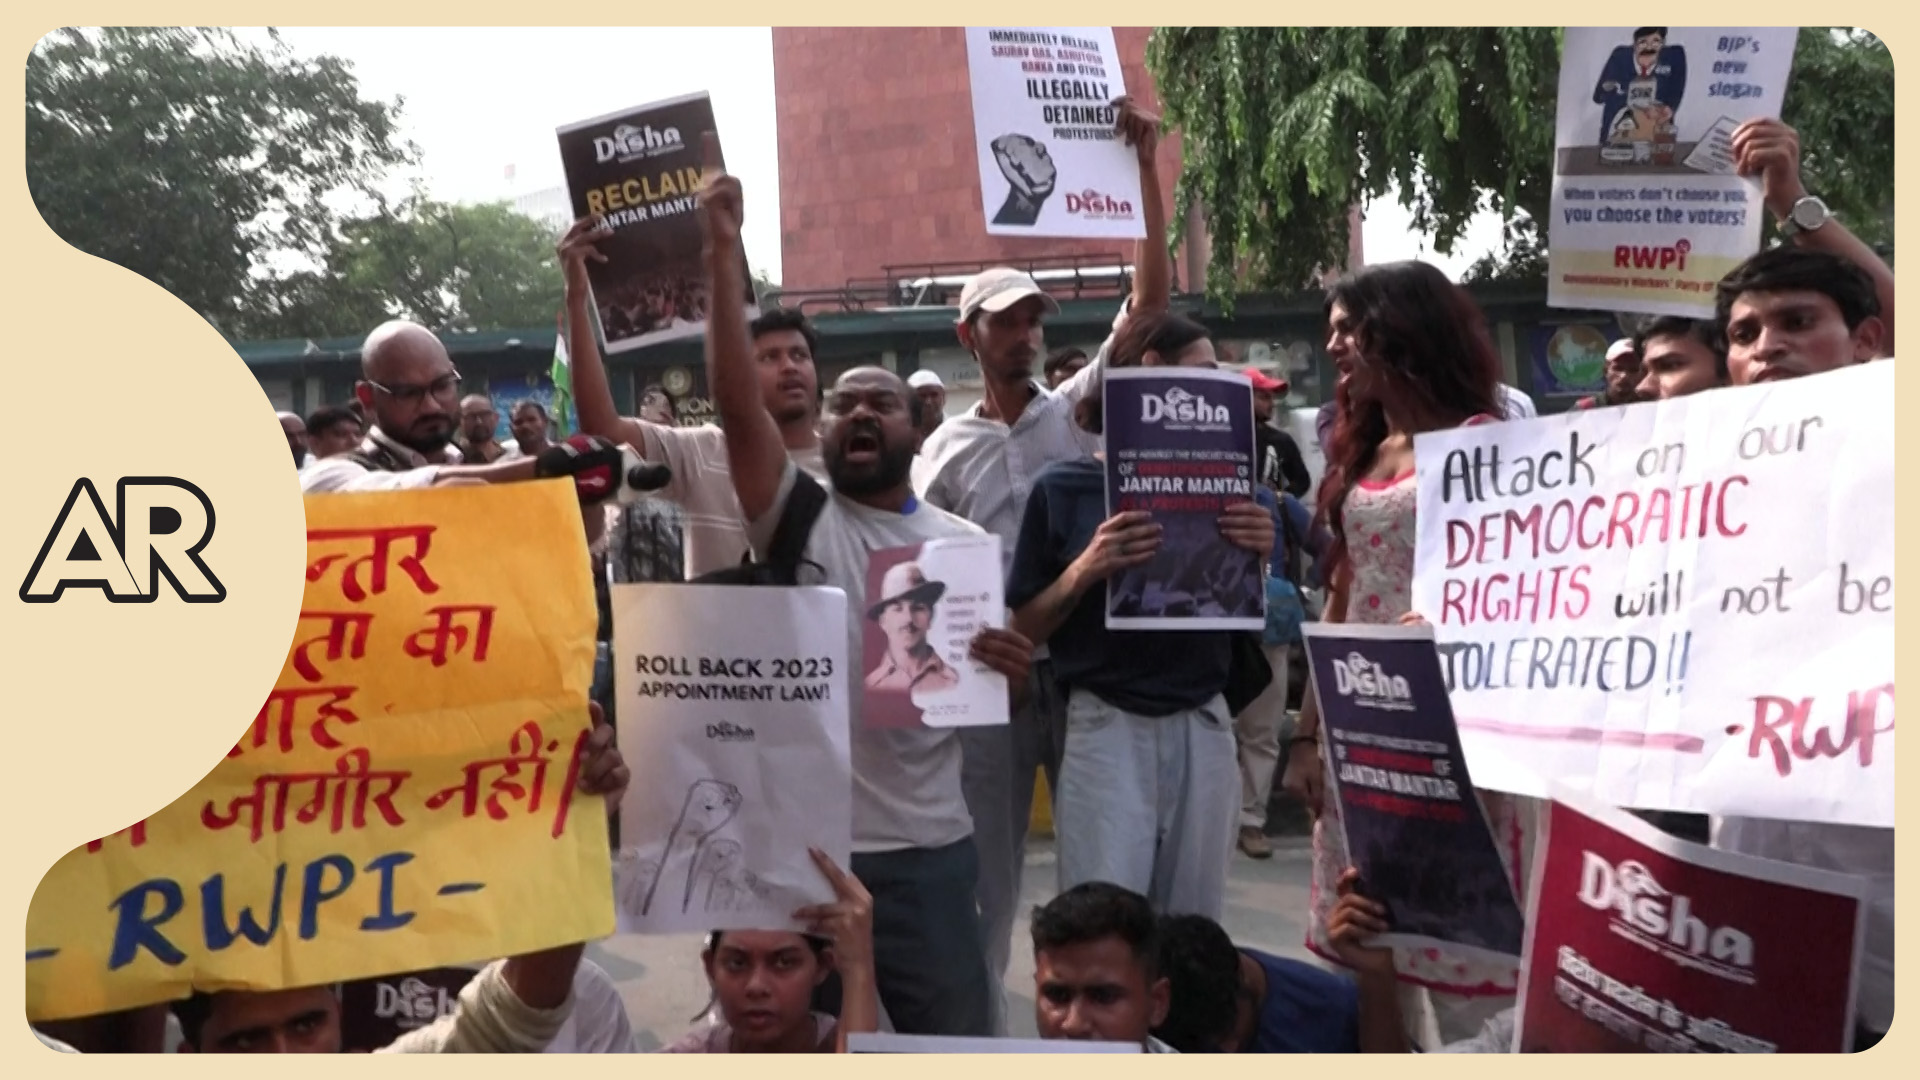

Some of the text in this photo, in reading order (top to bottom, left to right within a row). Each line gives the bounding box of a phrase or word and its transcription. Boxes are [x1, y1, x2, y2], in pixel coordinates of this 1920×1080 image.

[989, 30, 1057, 46] IMMEDIATELY
[1717, 36, 1760, 53] BJP's
[1056, 62, 1076, 74] AND
[1712, 61, 1748, 74] new
[1026, 78, 1109, 100] ILLEGALLY
[1708, 82, 1763, 99] slogan
[1043, 105, 1114, 124] DETAINED
[1564, 206, 1746, 226] you choose the voters!
[1140, 386, 1230, 423] Disha
[1441, 416, 1823, 502] Attack on our
[1119, 477, 1250, 494] JANTAR MANTAR
[1445, 475, 1751, 570] DEMOCRATIC
[1441, 561, 1893, 626] RIGHTS will not be
[402, 605, 497, 667] का
[636, 654, 833, 678] ROLL BACK 2023
[638, 682, 831, 701] APPOINTMENT LAW!
[200, 747, 412, 843] जागीर
[107, 851, 417, 971] RWPI
[1578, 850, 1755, 966] Disha
